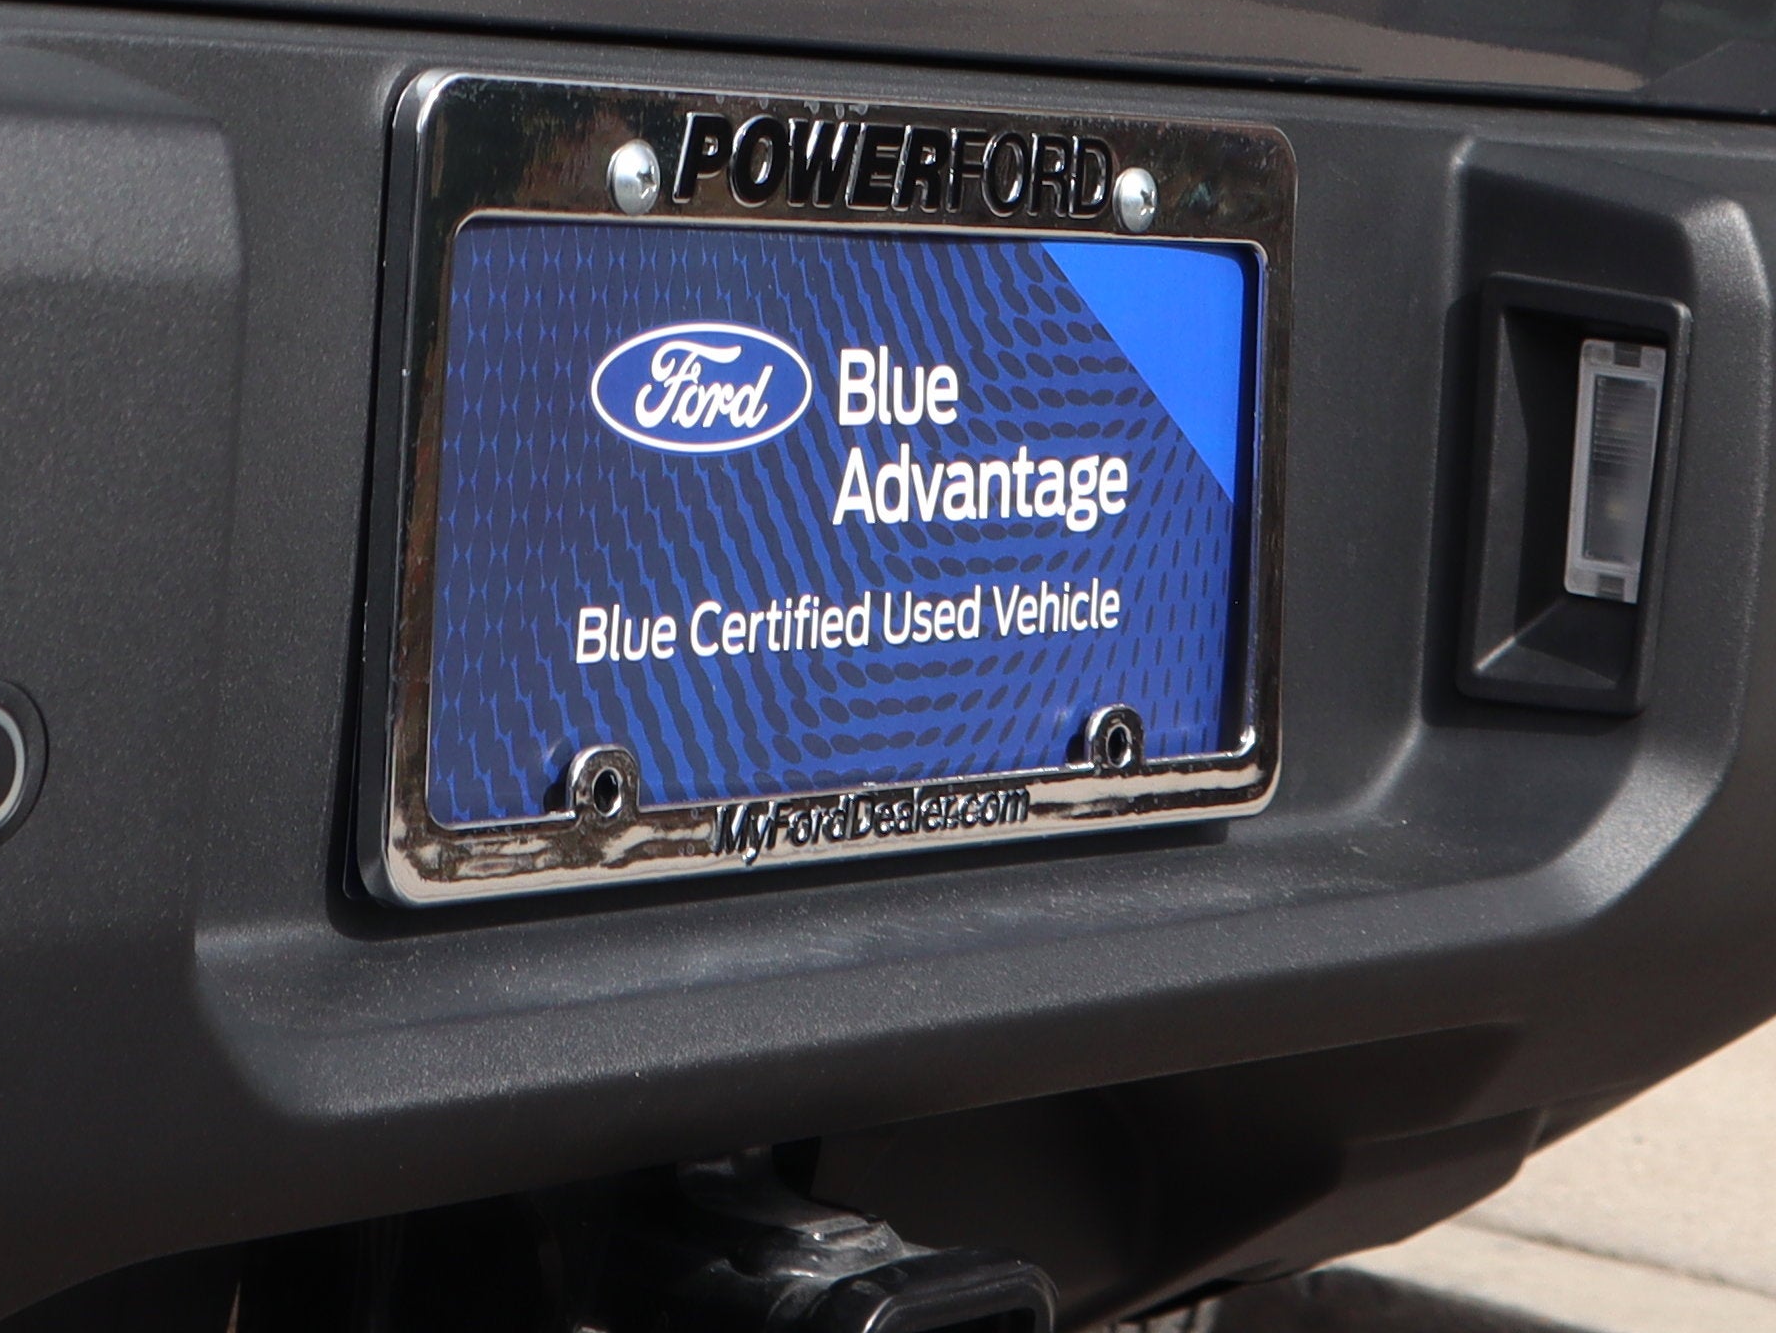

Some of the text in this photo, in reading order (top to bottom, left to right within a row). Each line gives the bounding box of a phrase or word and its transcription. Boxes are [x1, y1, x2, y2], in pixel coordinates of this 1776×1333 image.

[634, 341, 772, 430] Ford
[839, 346, 959, 427] Blue
[832, 445, 1129, 533] Advantage
[575, 577, 1122, 665] Blue Certified Used Vehicle
[712, 787, 1030, 864] MyFordDealer.com
